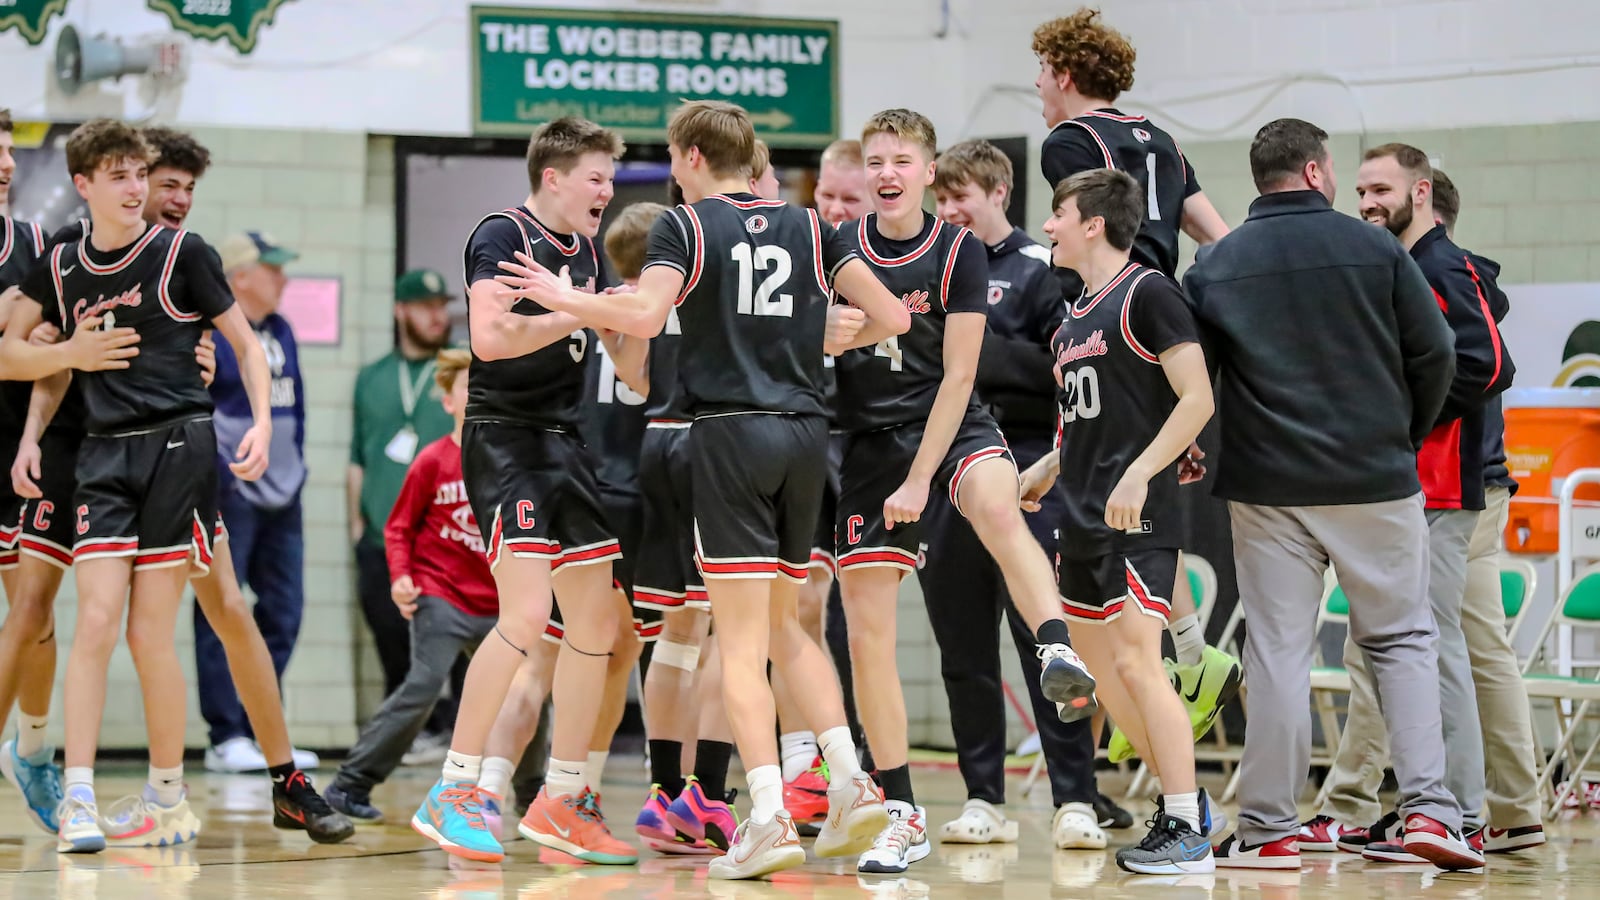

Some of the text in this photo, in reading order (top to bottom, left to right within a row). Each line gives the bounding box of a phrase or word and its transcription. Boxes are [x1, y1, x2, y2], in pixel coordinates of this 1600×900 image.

[480, 22, 829, 65] THE WOEBER FAMILY
[525, 59, 788, 97] LOCKER ROOMS
[1146, 152, 1161, 221] 1
[731, 241, 794, 318] 12
[1063, 365, 1102, 424] 20
[32, 500, 55, 531] C
[76, 504, 90, 536] C
[517, 500, 535, 529] C
[847, 514, 864, 545] C
